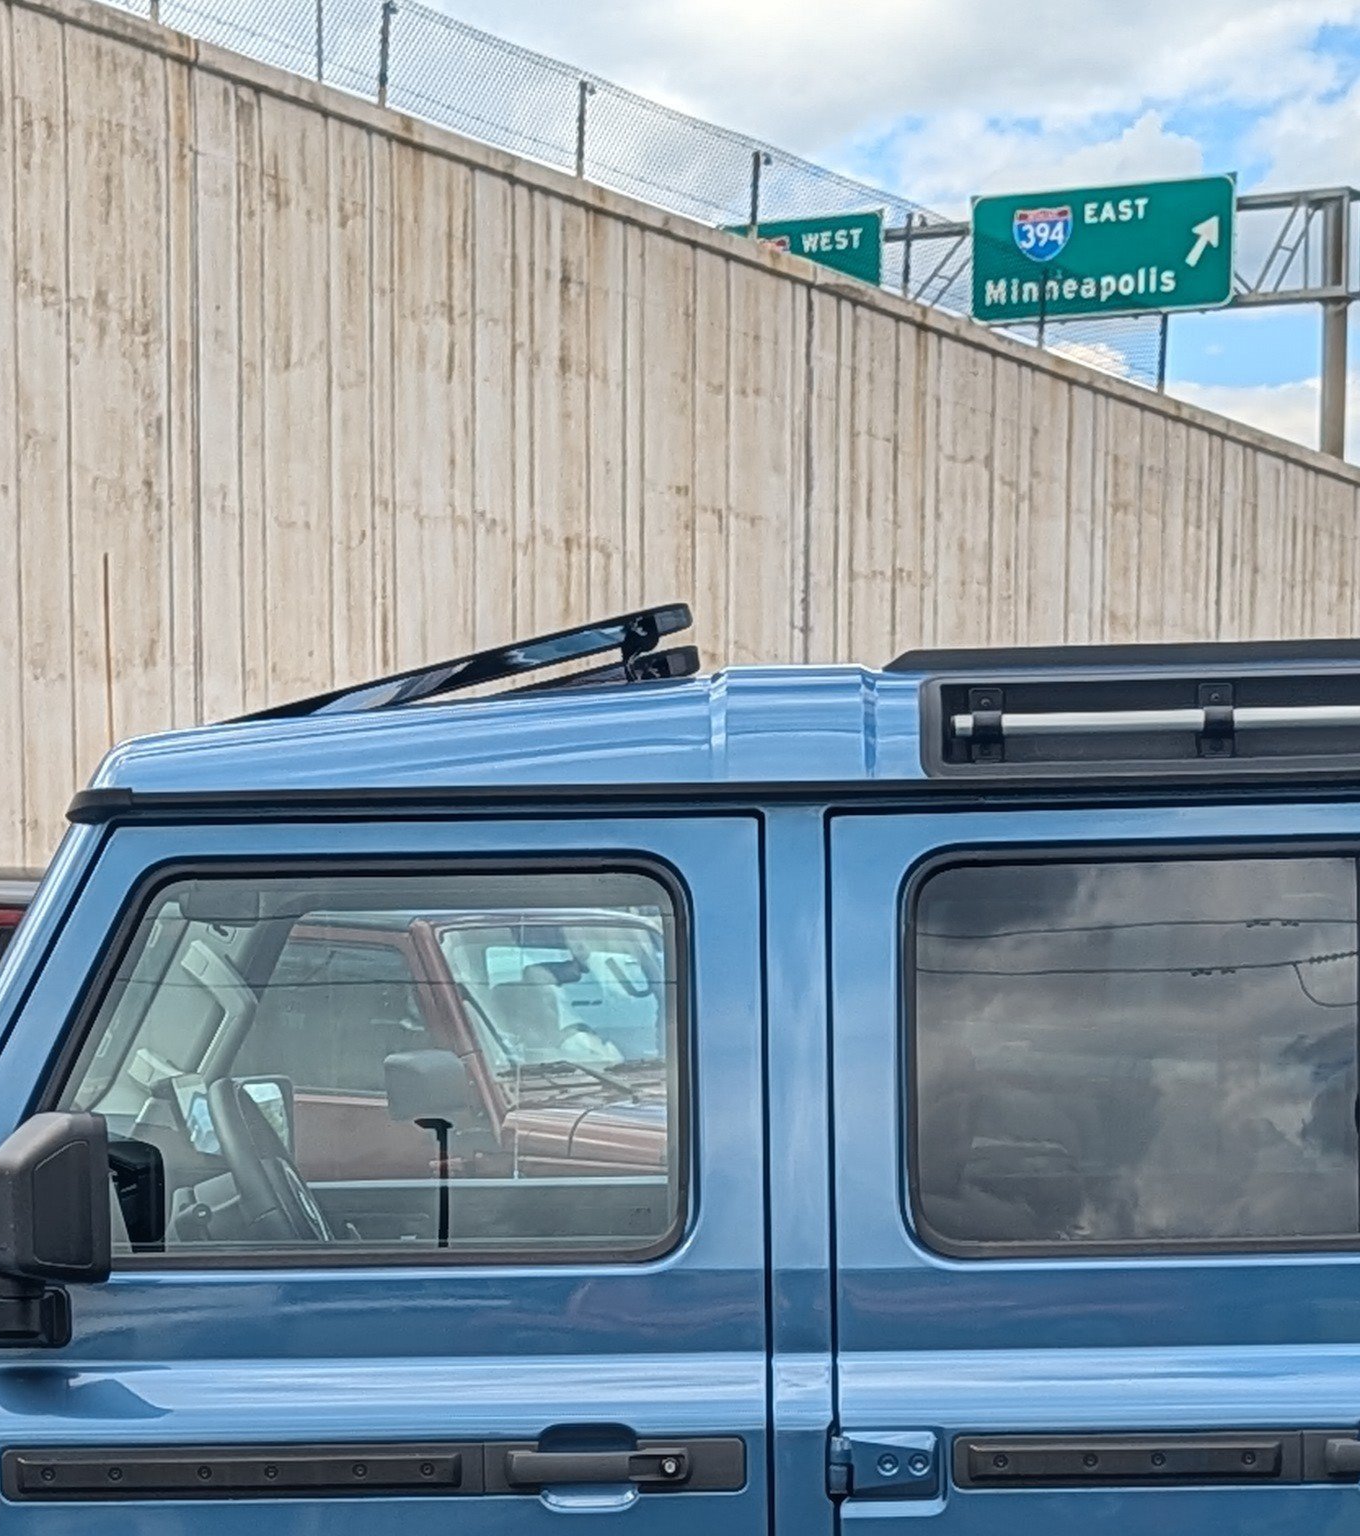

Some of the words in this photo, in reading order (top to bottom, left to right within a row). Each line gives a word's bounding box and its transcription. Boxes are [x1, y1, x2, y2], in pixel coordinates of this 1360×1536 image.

[1084, 197, 1149, 224] EAST
[801, 228, 863, 253] WEST
[1021, 221, 1065, 249] 394
[984, 266, 1177, 306] Minneapolis
